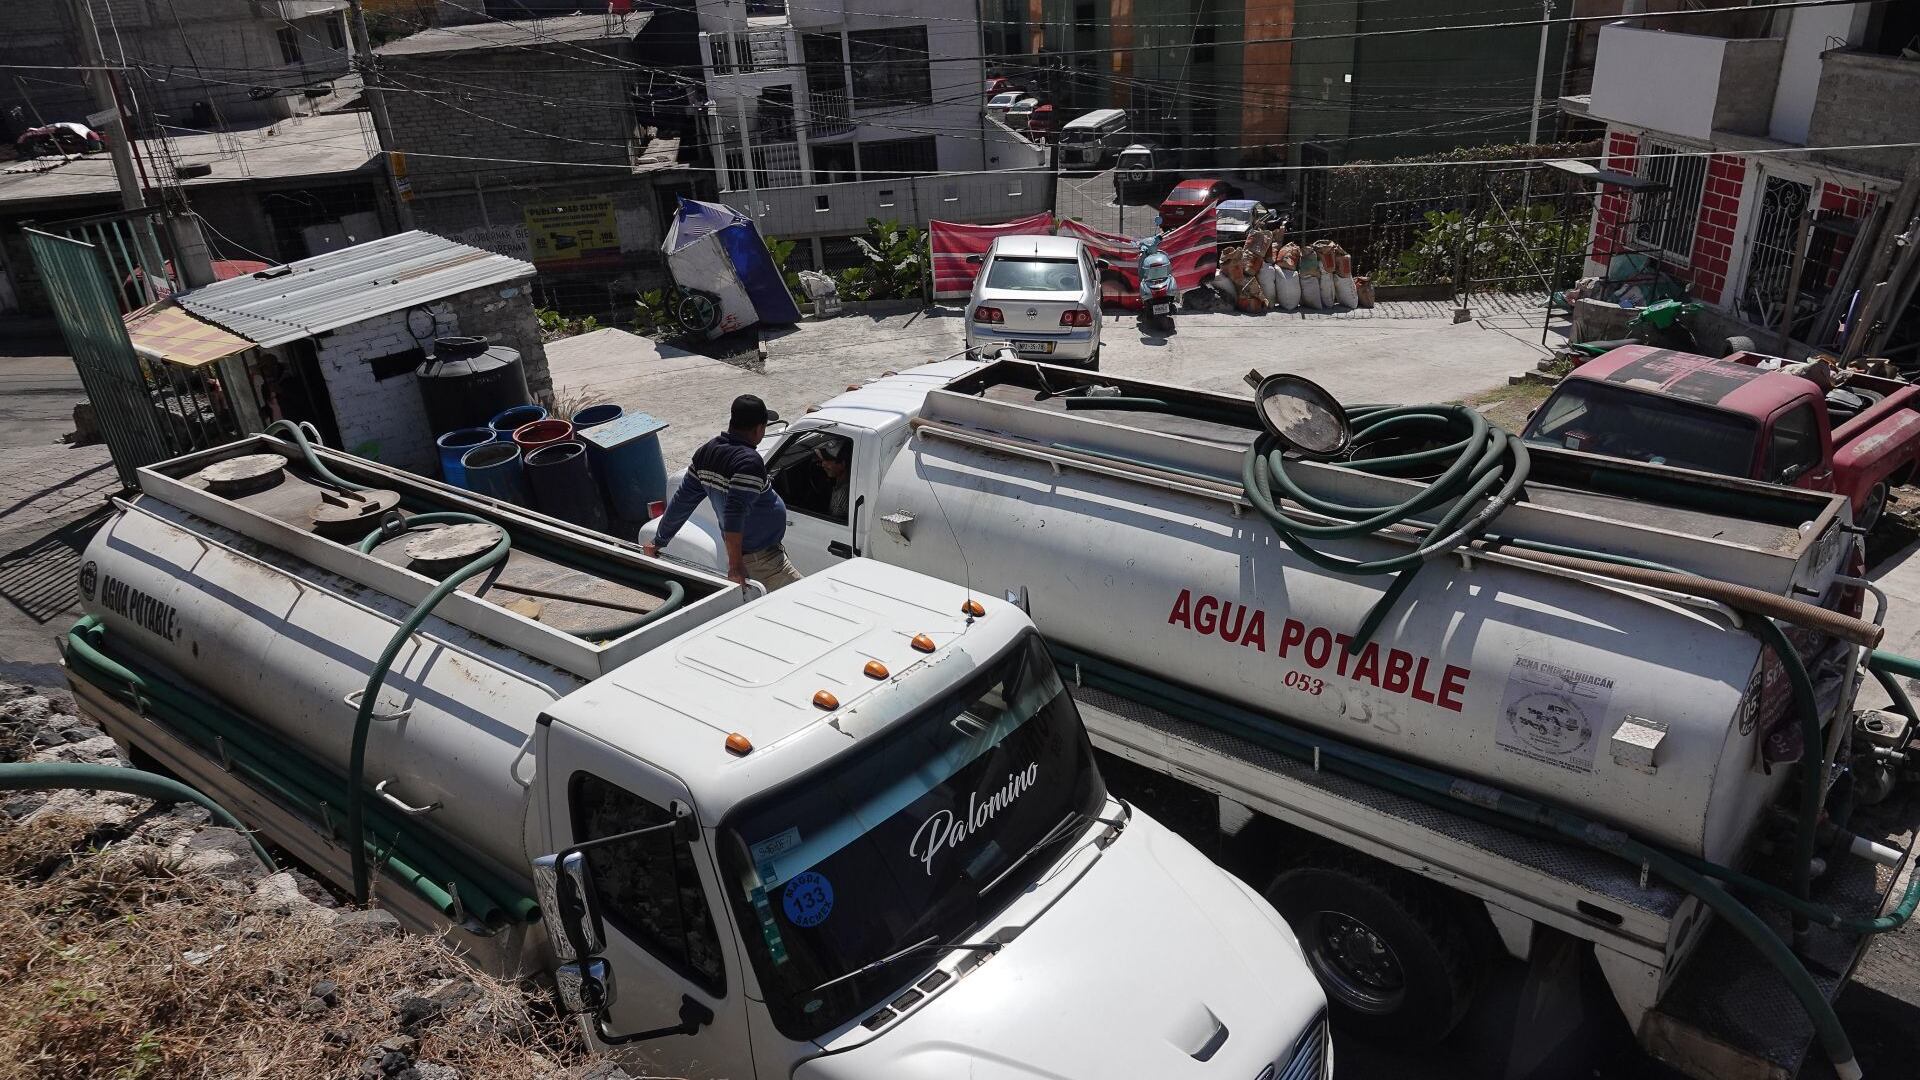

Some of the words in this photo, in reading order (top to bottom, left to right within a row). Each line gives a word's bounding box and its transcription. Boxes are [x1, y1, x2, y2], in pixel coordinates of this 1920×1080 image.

[102, 575, 130, 619] AGUA
[129, 588, 177, 642] POTABLE
[1168, 589, 1266, 652] AGUA
[1278, 618, 1471, 713] POTABLE
[1515, 657, 1539, 672] ZONA
[1284, 670, 1325, 697] 053
[909, 761, 1039, 876] Palomino
[785, 874, 821, 898] MAGDA
[793, 887, 825, 913] 133
[796, 901, 832, 926] SACMEX
